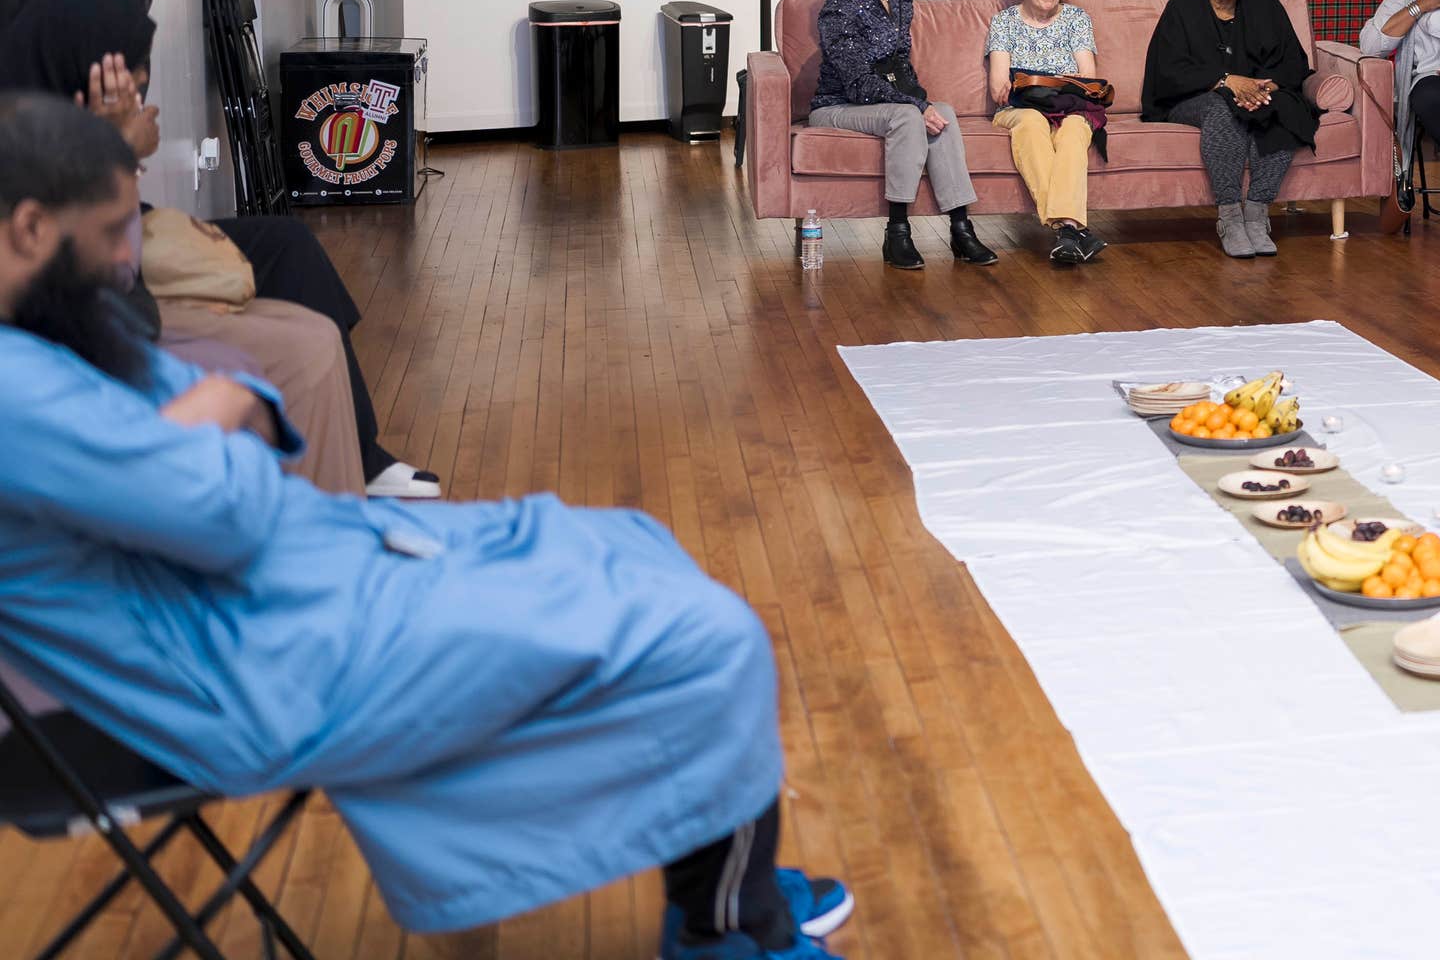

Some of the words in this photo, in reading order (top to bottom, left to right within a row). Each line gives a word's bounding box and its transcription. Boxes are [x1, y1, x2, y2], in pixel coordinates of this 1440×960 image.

[365, 111, 387, 121] ALUMNI
[298, 141, 343, 185] GOURMET
[343, 164, 379, 185] FRUIT
[374, 139, 397, 170] POPS
